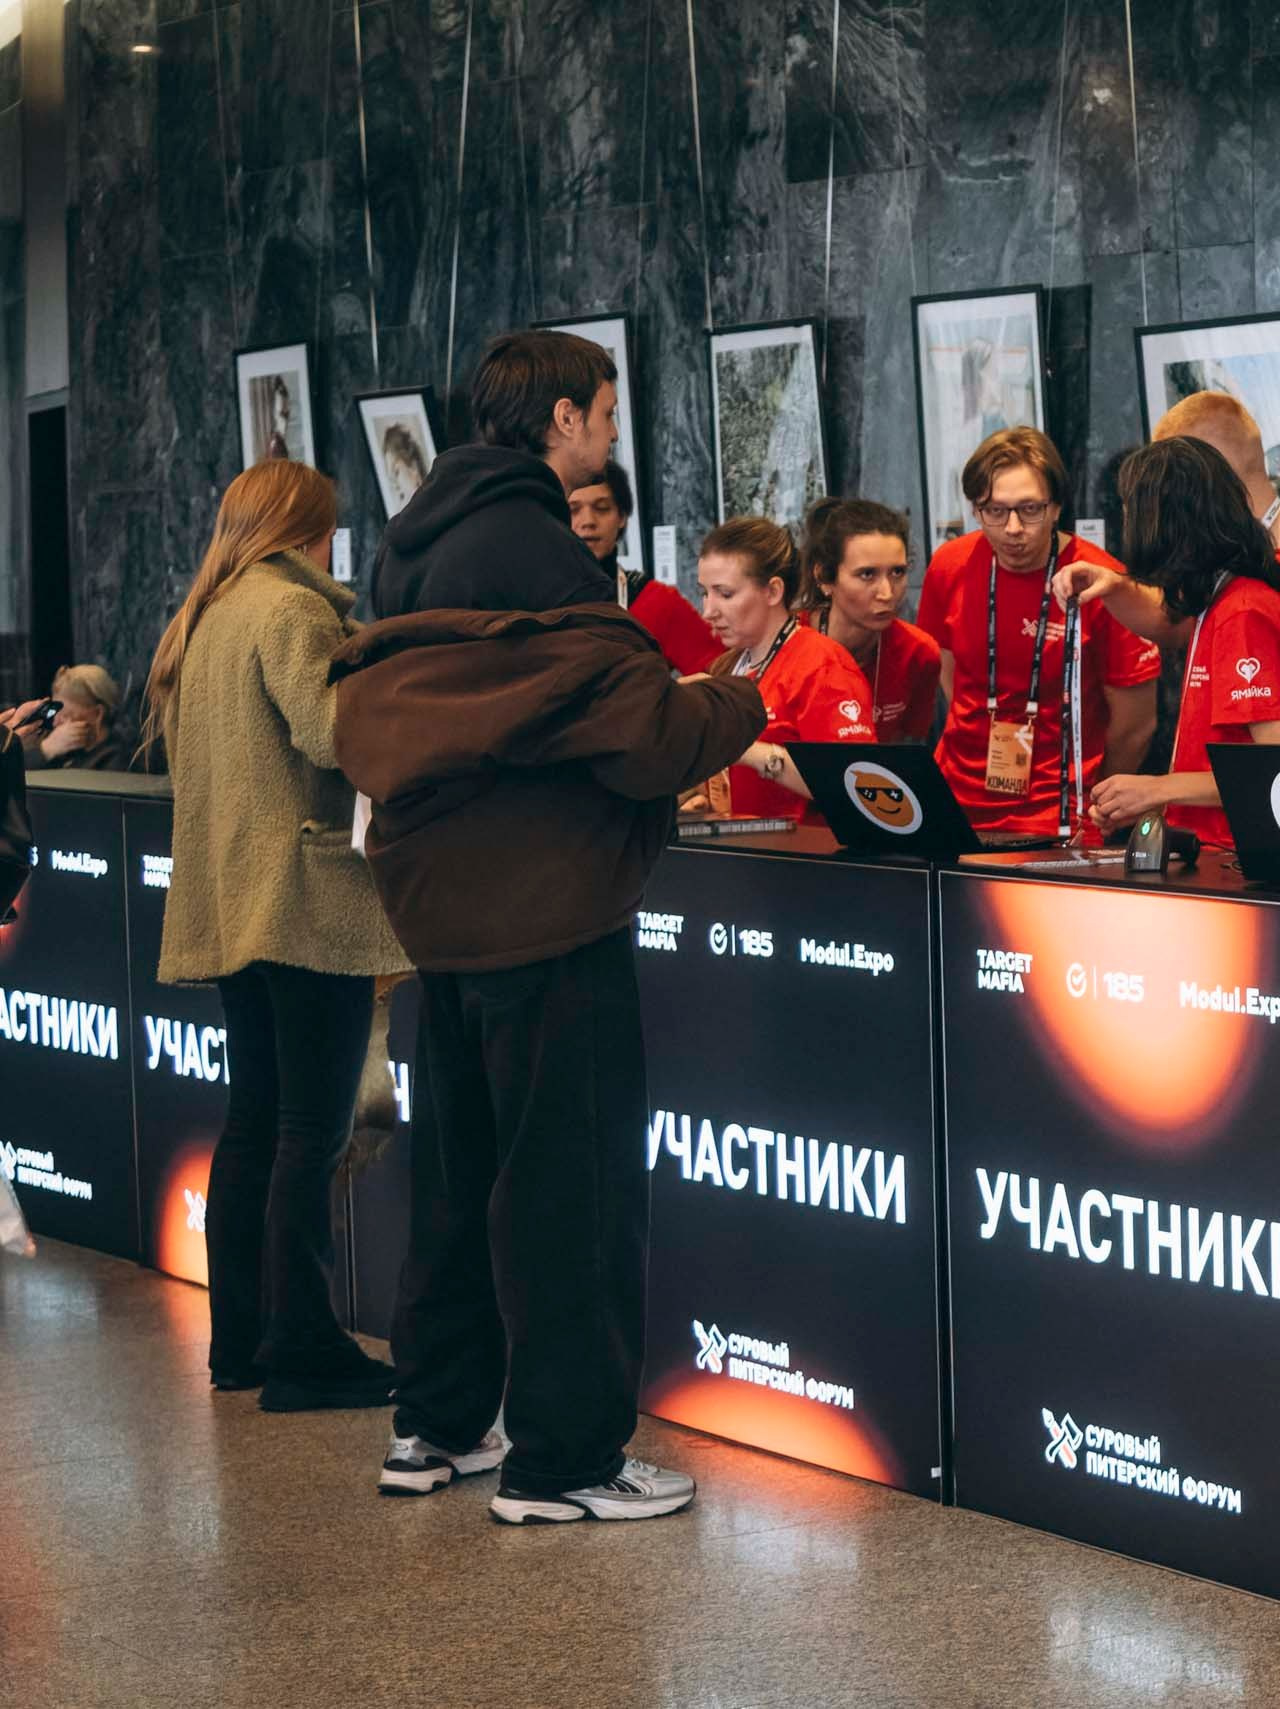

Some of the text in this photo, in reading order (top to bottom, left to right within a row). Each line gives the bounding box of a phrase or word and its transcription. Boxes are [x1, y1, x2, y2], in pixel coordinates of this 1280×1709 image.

[986, 775, 1029, 795] КОМАНДА
[637, 912, 684, 934] TARGET
[638, 932, 678, 952] MAFIA
[739, 929, 774, 957] 185
[800, 937, 895, 977] Modul.Expo
[976, 948, 1033, 974] TARGET
[977, 970, 1025, 994] MAFIA
[1103, 971, 1145, 1003] 185
[145, 1015, 231, 1085] УЧАСТ
[647, 1109, 906, 1224] УЧАСТНИКИ
[728, 1332, 790, 1367] СУРОВЫЙ
[728, 1357, 855, 1410] ПИТЕРСКИЙ ФОРУМ
[1085, 1424, 1161, 1464] СУРОВЫЙ
[1086, 1451, 1242, 1513] ПИТЕРСКИЙ ФОРУМ
